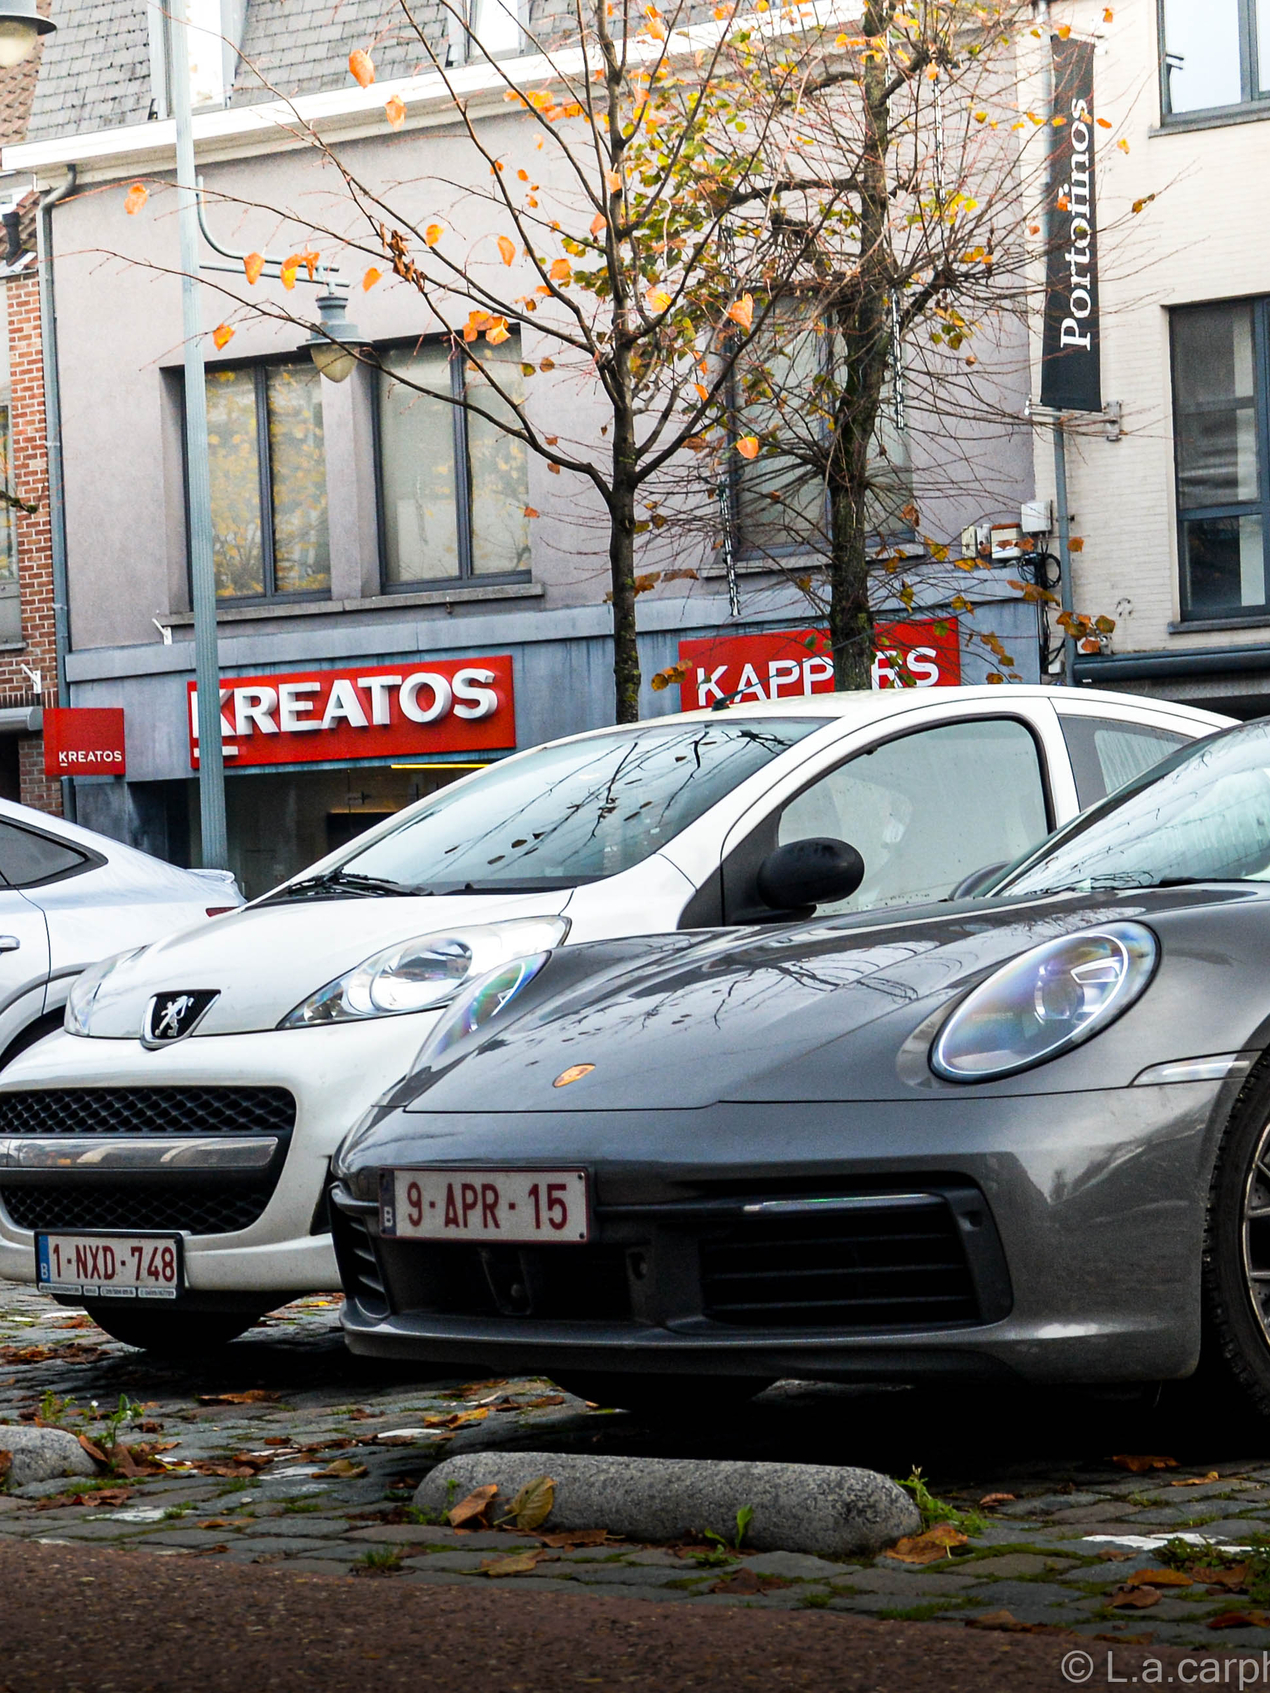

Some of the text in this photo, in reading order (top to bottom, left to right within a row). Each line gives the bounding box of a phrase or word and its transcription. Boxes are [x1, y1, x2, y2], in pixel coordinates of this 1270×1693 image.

[697, 647, 941, 707] KAPPRS
[59, 750, 122, 763] KREATOS
[383, 1205, 394, 1227] B
[40, 1262, 49, 1279] B
